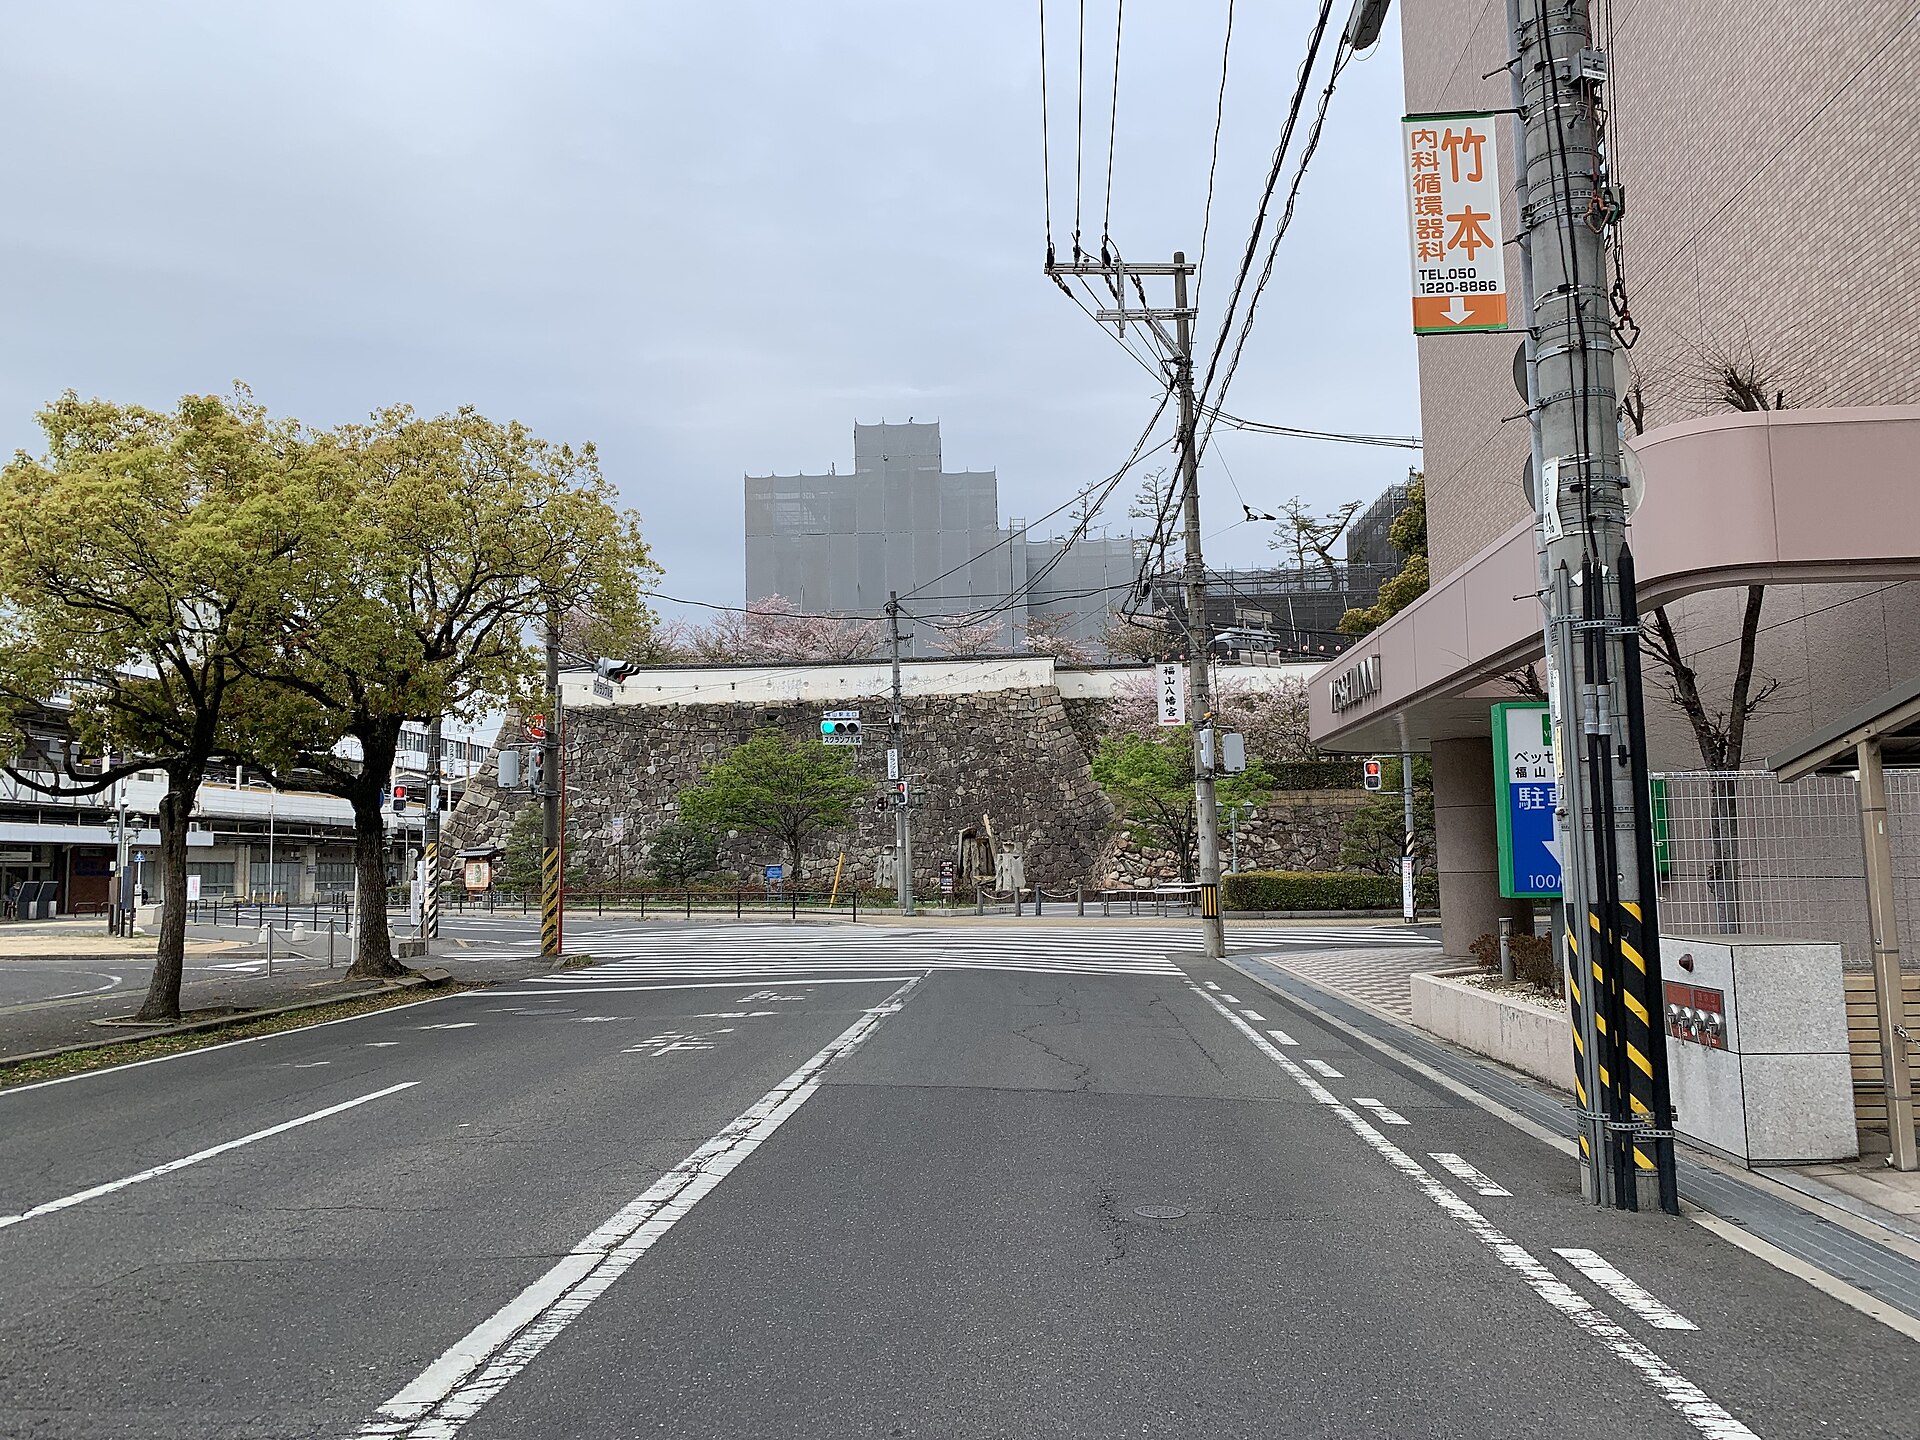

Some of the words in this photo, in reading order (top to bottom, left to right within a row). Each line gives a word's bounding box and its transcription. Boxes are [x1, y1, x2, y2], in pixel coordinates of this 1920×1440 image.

[1411, 128, 1446, 263] 内科循環器科
[1441, 127, 1494, 262] 竹本
[1418, 267, 1477, 281] TEL.050
[1419, 280, 1498, 294] 1220-8886
[1163, 665, 1178, 717] 福山八幡宮
[824, 736, 861, 744] スクランブル式
